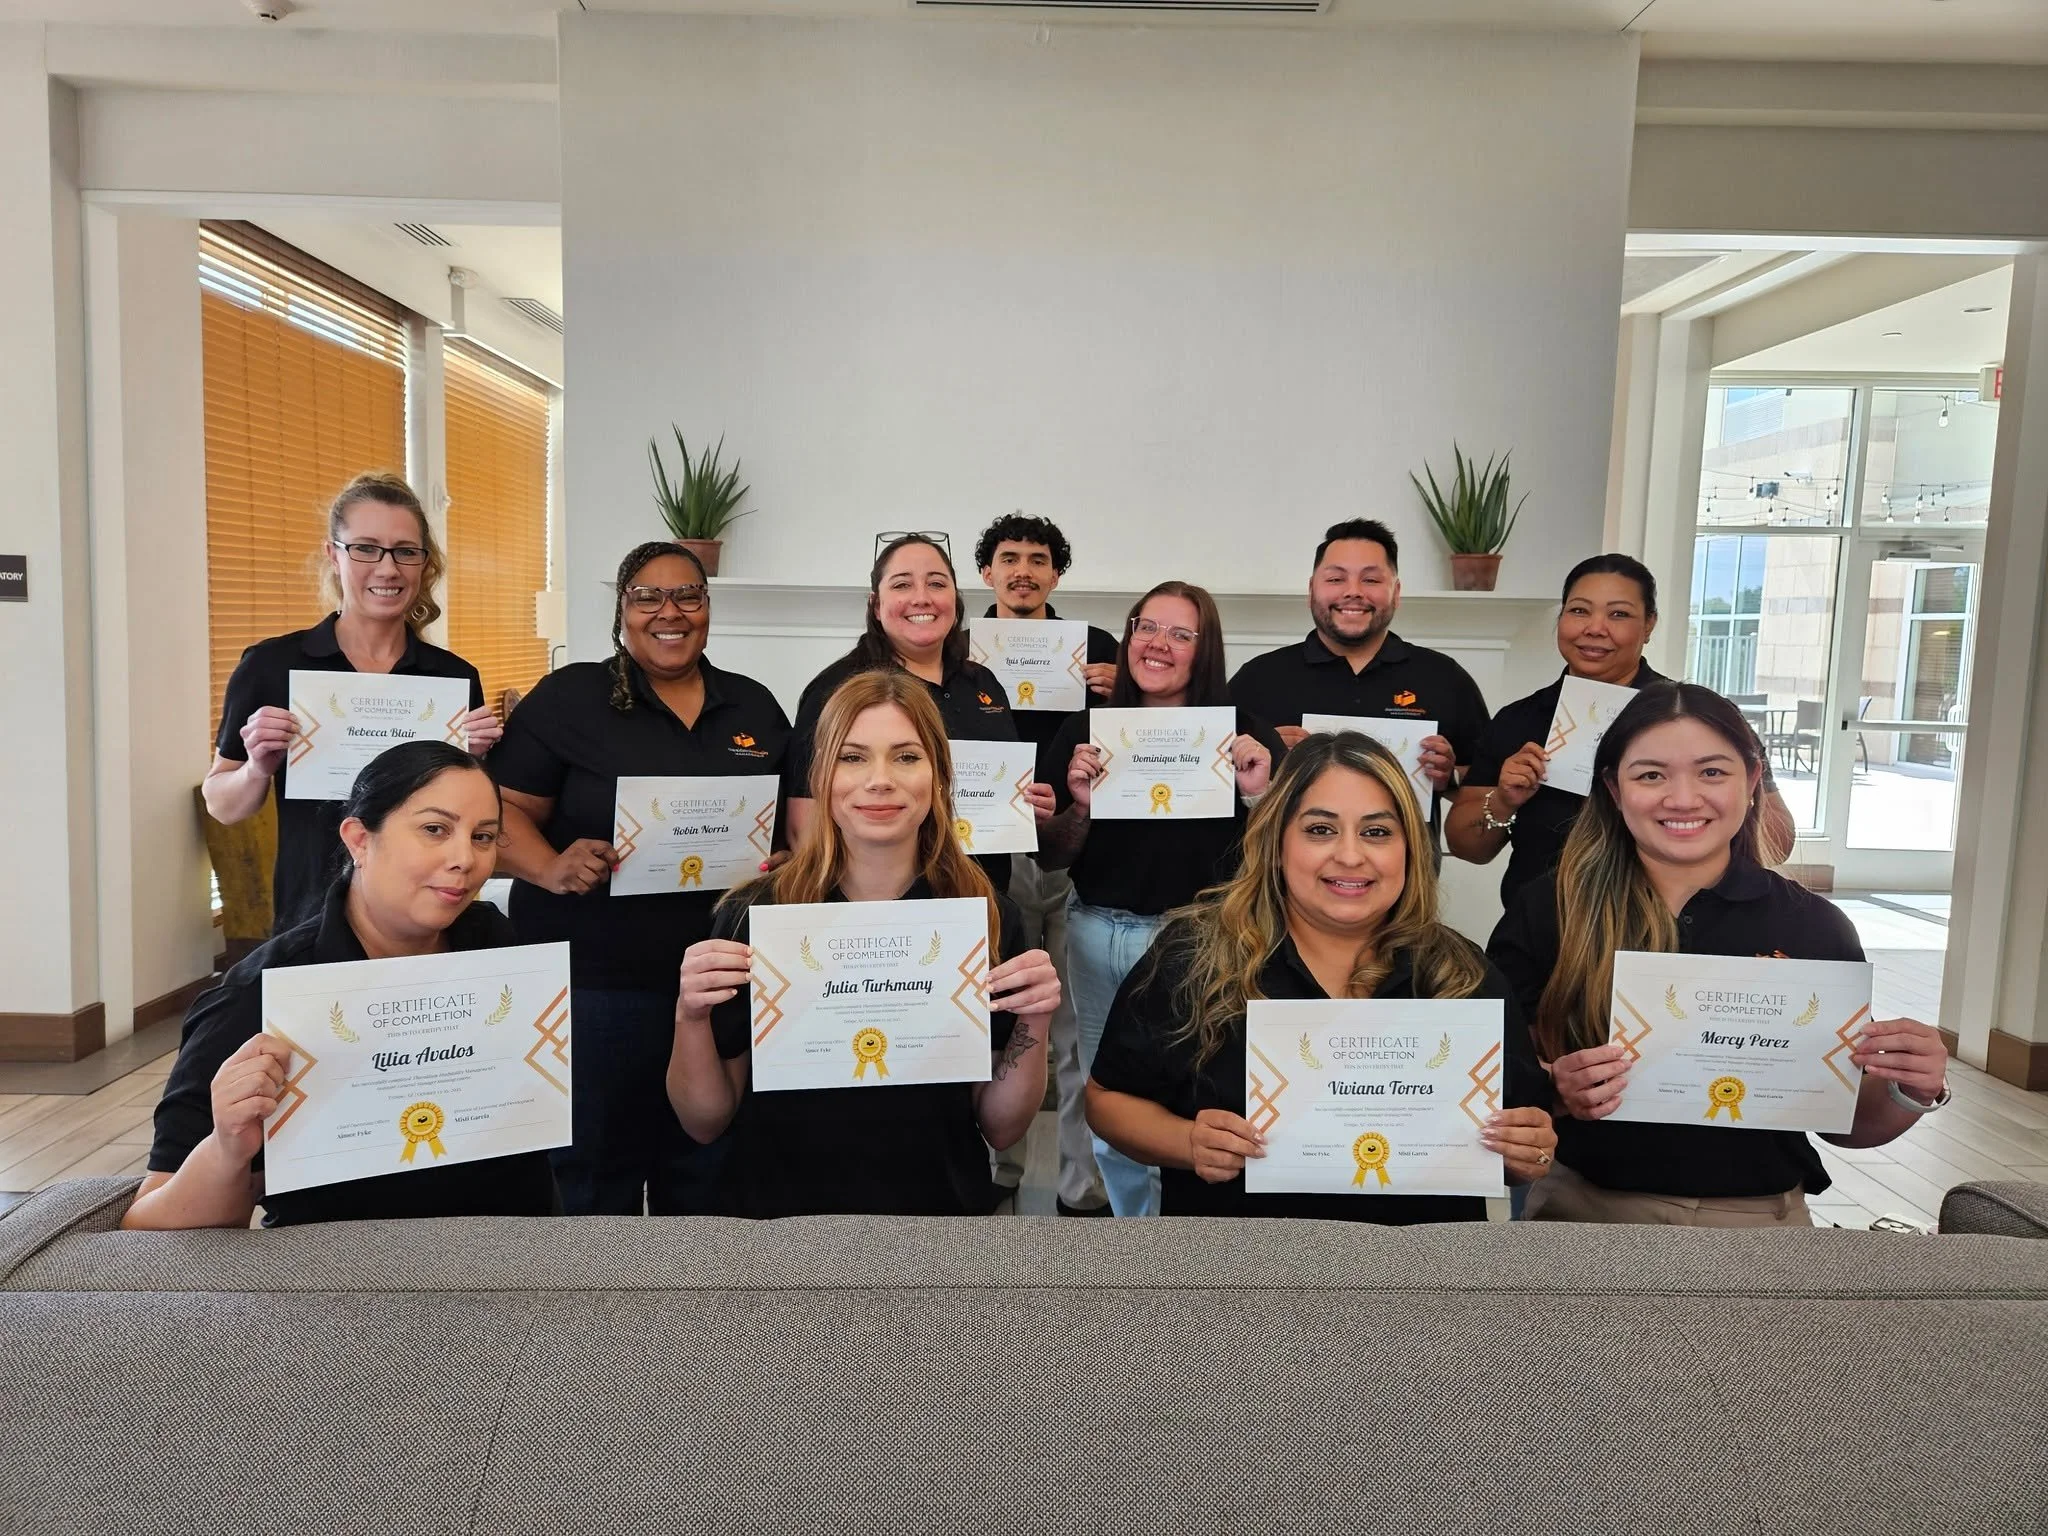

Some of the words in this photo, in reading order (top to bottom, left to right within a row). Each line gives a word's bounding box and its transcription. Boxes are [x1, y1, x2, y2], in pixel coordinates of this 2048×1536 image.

[1008, 636, 1048, 644] CERTIFICATE
[1006, 658, 1018, 666] Luis
[350, 697, 415, 708] CERTIFICATE
[366, 706, 411, 714] COMPLETION
[346, 726, 388, 737] Rebecca
[390, 727, 416, 738] Blair
[1136, 728, 1189, 736] CERTIFICATE
[1132, 754, 1177, 764] Dominique
[957, 788, 995, 798] Alvarado
[670, 800, 728, 808] CERTIFICATE
[672, 826, 698, 836] Robin
[700, 824, 729, 834] Norris
[828, 936, 912, 950] CERTIFICATE
[832, 952, 846, 961] OF
[846, 950, 909, 960] COMPLETION
[822, 978, 858, 998] Julia
[861, 979, 934, 995] Turkmany
[367, 992, 477, 1016] CERTIFICATE
[1694, 990, 1788, 1006] CERTIFICATE
[1698, 1003, 1713, 1012] OF
[1714, 1005, 1782, 1016] COMPLETION
[373, 1018, 388, 1028] OF
[392, 1009, 472, 1027] COMPLETION
[1328, 1036, 1419, 1049] CERTIFICATE
[1700, 1030, 1746, 1050] Mercy
[1750, 1033, 1790, 1049] Perez
[372, 1052, 412, 1072] Lilia
[416, 1044, 475, 1065] Avalos
[1333, 1052, 1348, 1060] OF
[1348, 1051, 1415, 1060] COMPLETION
[1328, 1080, 1385, 1096] Viviana
[1389, 1080, 1434, 1096] Torres
